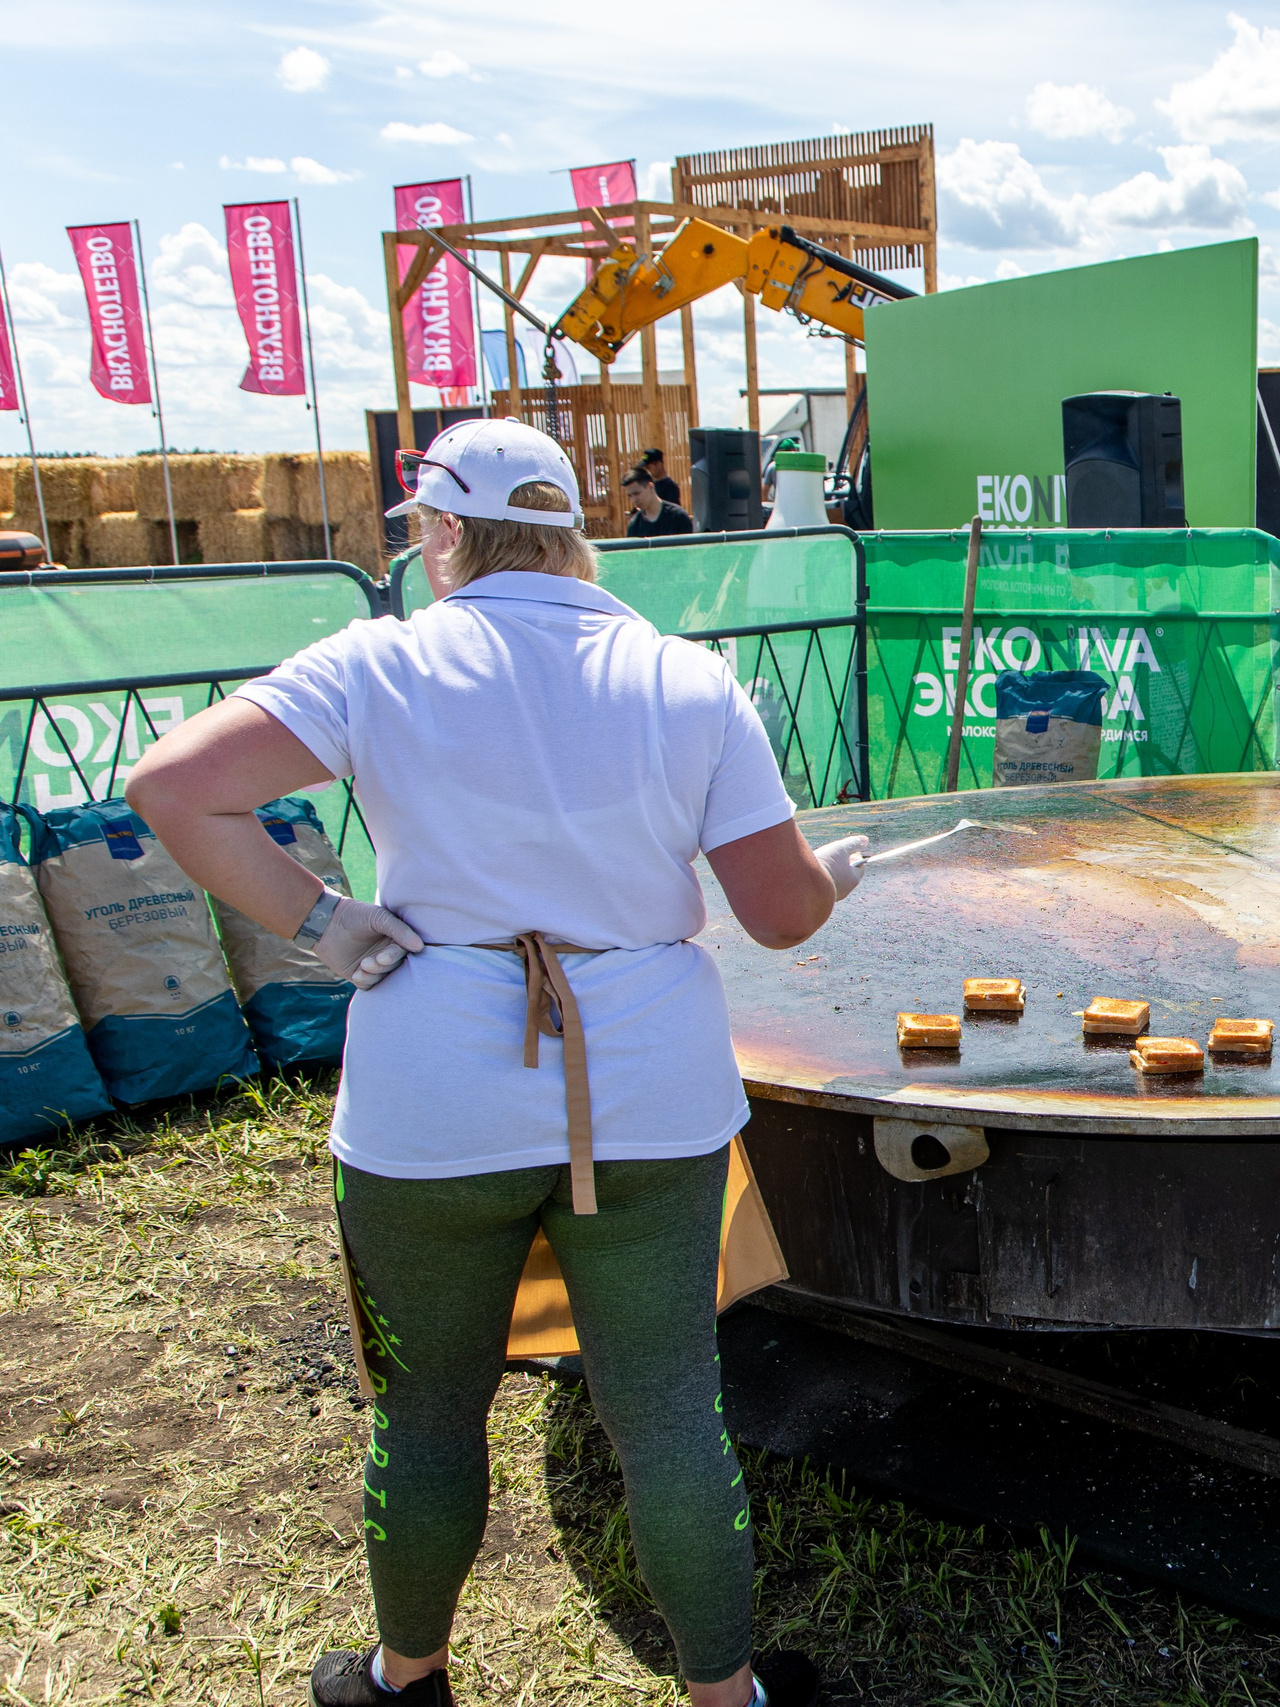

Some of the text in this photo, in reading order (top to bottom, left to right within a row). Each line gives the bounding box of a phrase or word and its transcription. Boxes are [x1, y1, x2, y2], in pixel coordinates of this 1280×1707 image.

[977, 474, 1066, 522] EKONI
[942, 626, 1161, 672] EKONIVA
[1101, 729, 1148, 742] РДИМСЯ
[1019, 762, 1074, 773] ДРЕВЕСНЫЙ
[84, 890, 196, 920] УГОЛЬ ДРЕВЕСНЫЙ
[108, 905, 187, 930] БЕРЕЗОВЫЙ
[175, 1026, 196, 1036] 10 КГ
[17, 1062, 41, 1075] 10 КГ
